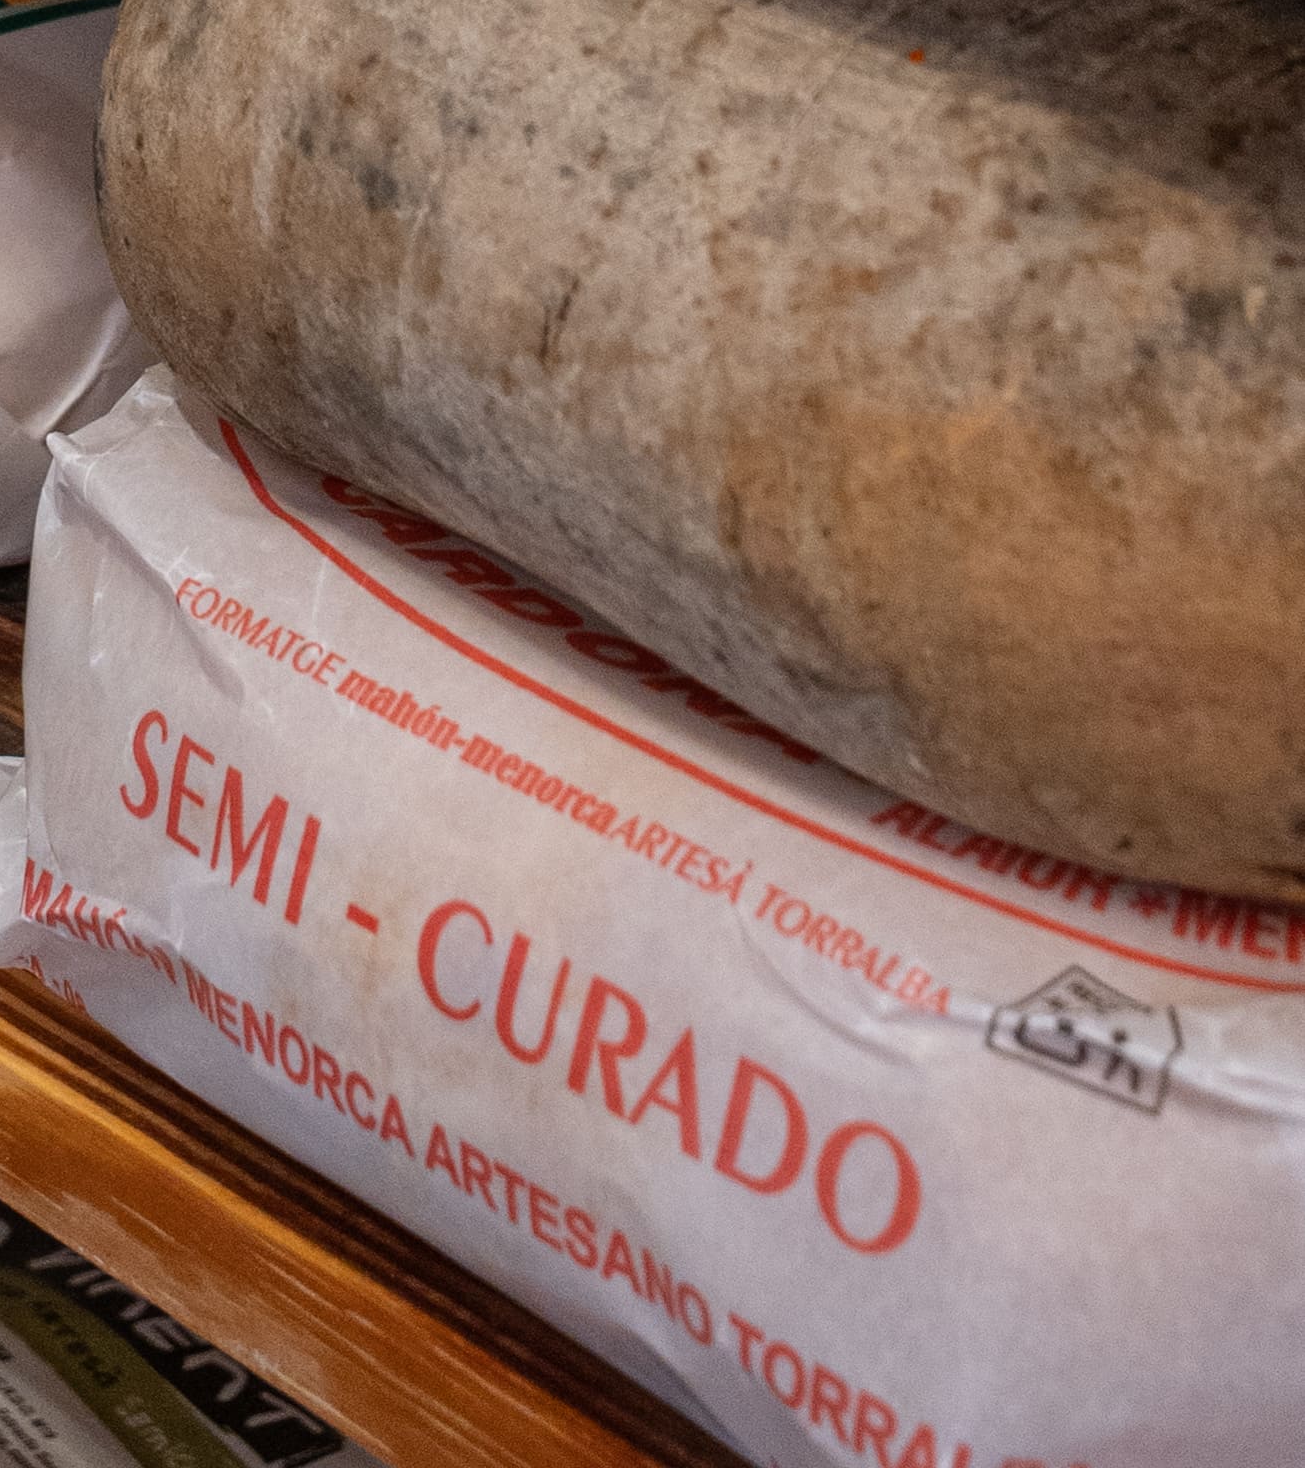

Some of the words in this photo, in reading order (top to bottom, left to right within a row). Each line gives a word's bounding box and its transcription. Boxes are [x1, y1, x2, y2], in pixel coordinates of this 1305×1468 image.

[119, 709, 323, 926] SEMI
[416, 899, 924, 1257] CURADO
[175, 575, 346, 687] FORMATGE
[334, 668, 618, 837] mahón-menorca
[609, 813, 754, 905] ARTESÀ
[753, 883, 953, 1017] TORRALBA
[21, 856, 178, 985] MAHÓN
[180, 956, 417, 1159] MENORCA
[424, 1122, 717, 1348] ARTESANO
